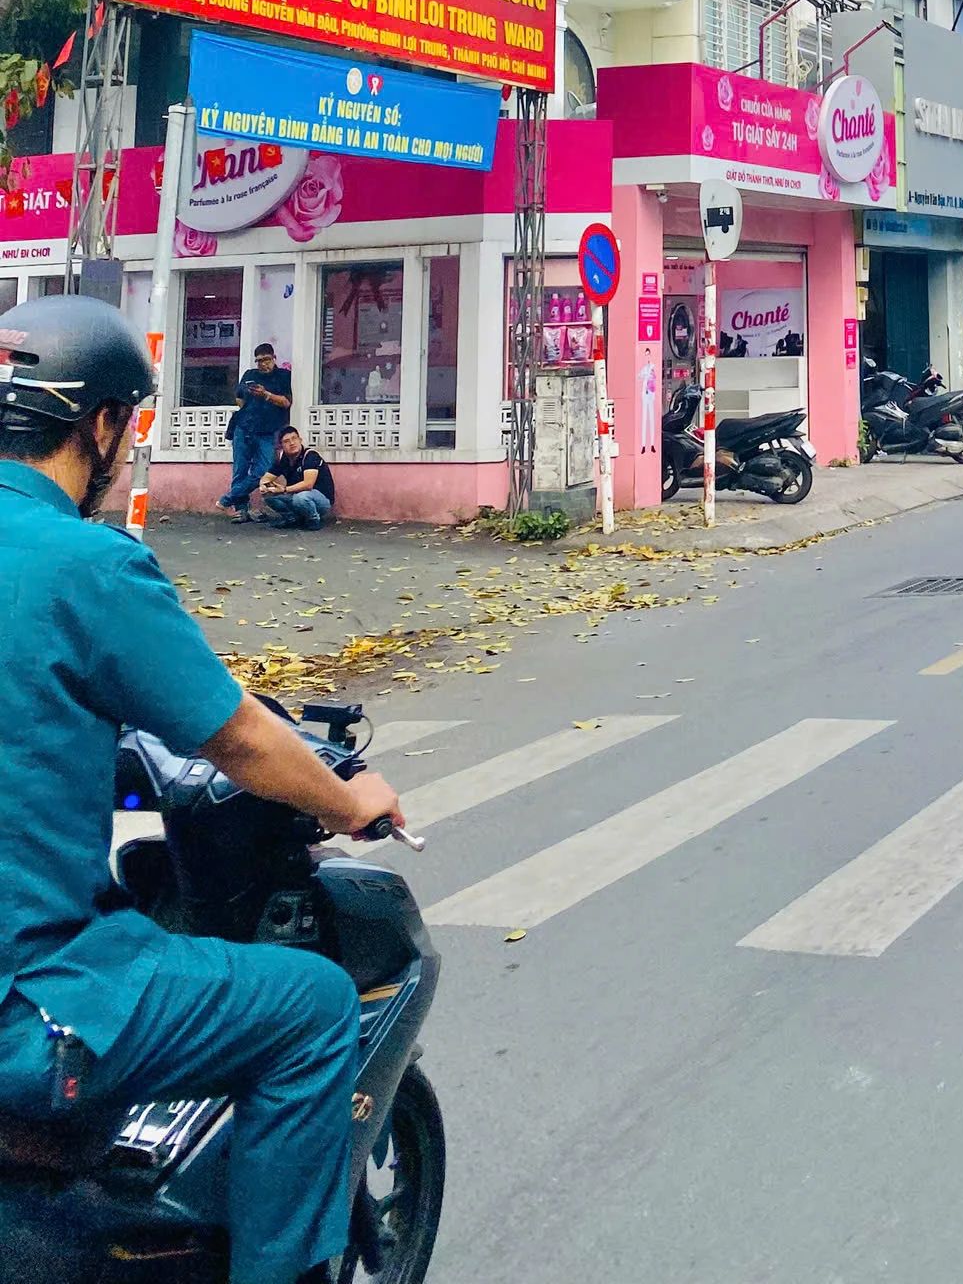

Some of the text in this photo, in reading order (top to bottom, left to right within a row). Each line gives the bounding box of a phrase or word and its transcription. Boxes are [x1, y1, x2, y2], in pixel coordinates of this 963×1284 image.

[296, 6, 315, 28] VĂN
[341, 19, 378, 44] PHƯỜNG
[379, 28, 401, 48] BÌNH
[453, 46, 480, 65] THÀNH
[448, 6, 496, 41] TRUNG
[504, 20, 544, 52] WARD
[201, 102, 219, 129] KỶ
[223, 111, 275, 136] NGUYÊN
[279, 116, 308, 140] BÌNH
[347, 126, 360, 147] VÀ
[364, 131, 379, 150] AN
[383, 131, 409, 154] TOÀN
[411, 137, 431, 157] CHO
[318, 92, 402, 127] KỶ NGUYÊN SỐ:
[831, 103, 876, 144] Chanté
[782, 132, 798, 152] 24H
[731, 303, 790, 331] Chanté
